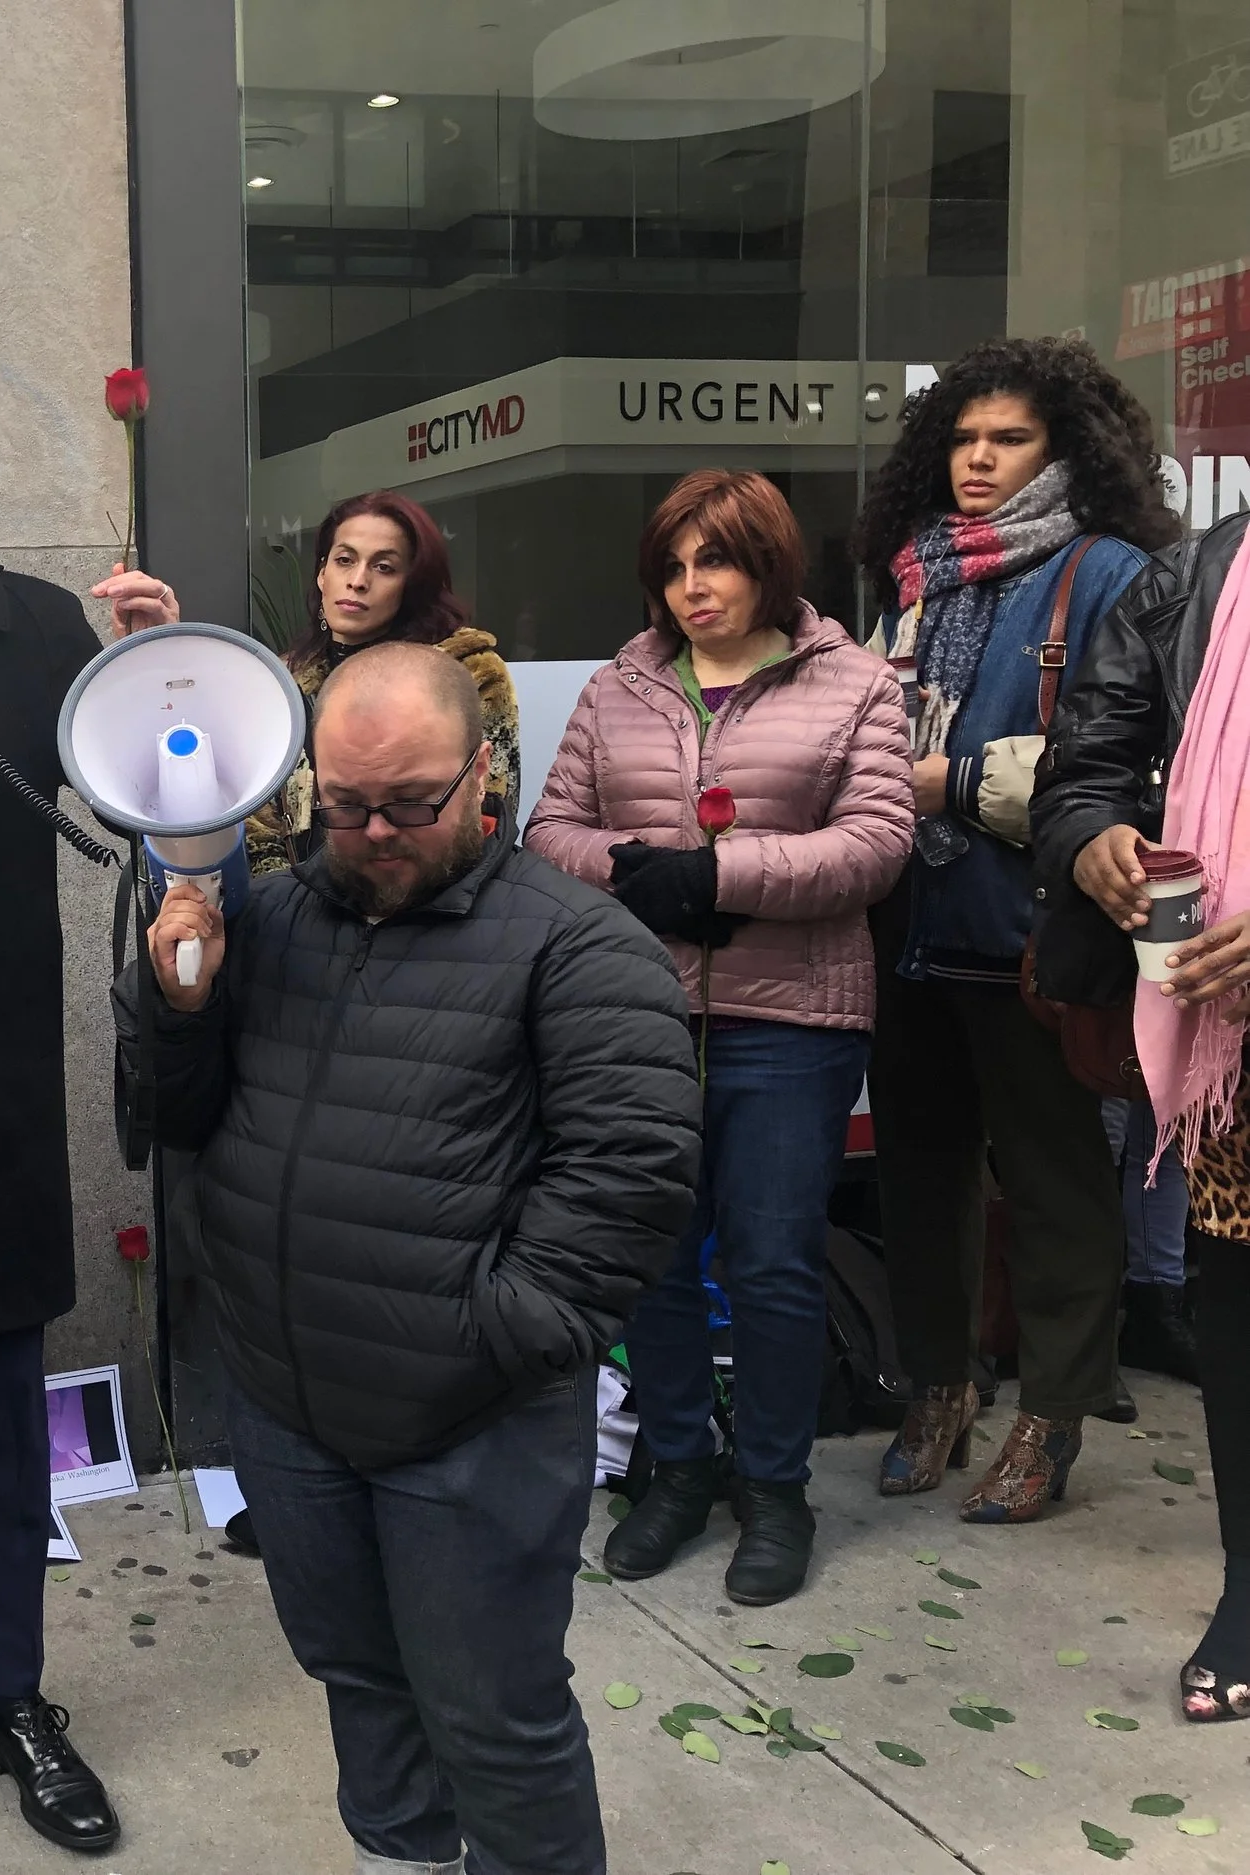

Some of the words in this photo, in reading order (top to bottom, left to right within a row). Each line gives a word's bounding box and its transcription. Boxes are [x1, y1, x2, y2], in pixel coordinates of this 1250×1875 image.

[1181, 337, 1229, 367] Self
[619, 381, 834, 422] URGENT
[427, 395, 525, 455] CITYMD
[68, 1466, 110, 1479] Washington
